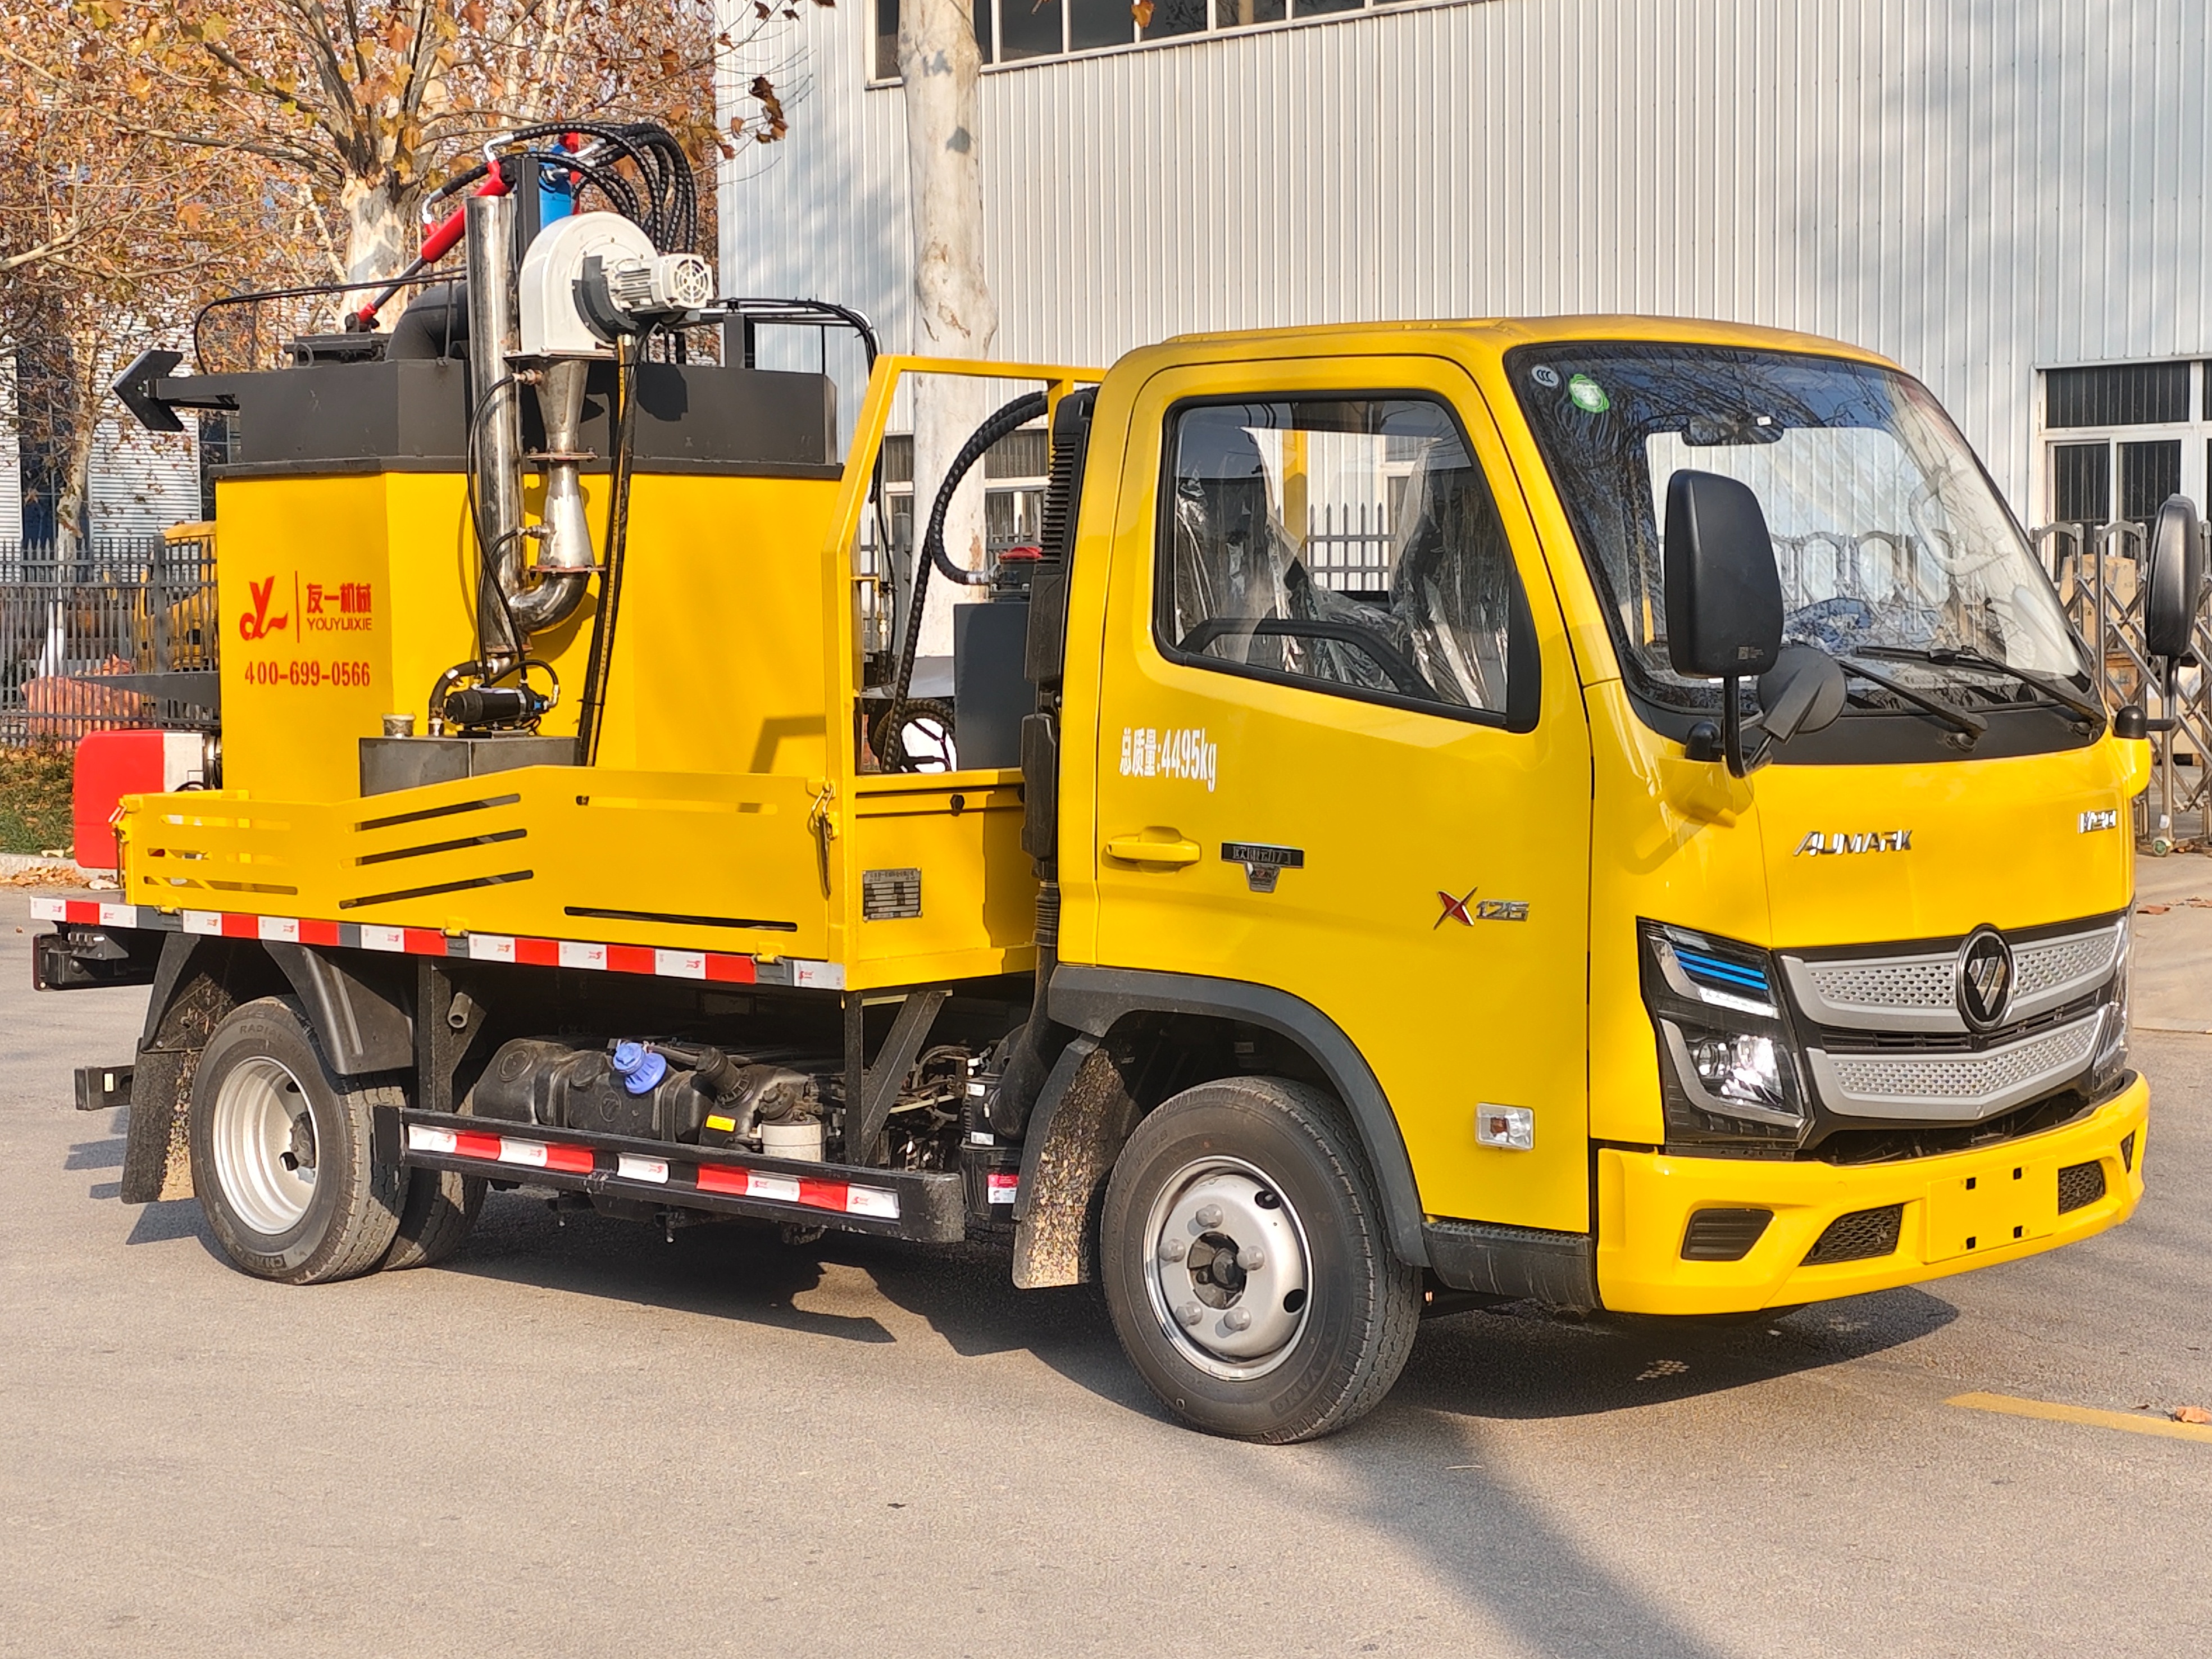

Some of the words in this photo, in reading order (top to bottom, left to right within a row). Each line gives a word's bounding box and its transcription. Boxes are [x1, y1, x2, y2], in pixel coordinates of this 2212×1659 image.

[306, 583, 372, 613] 友一机械
[244, 661, 371, 687] 400-699-0566
[1792, 829, 1913, 857] AUMARK
